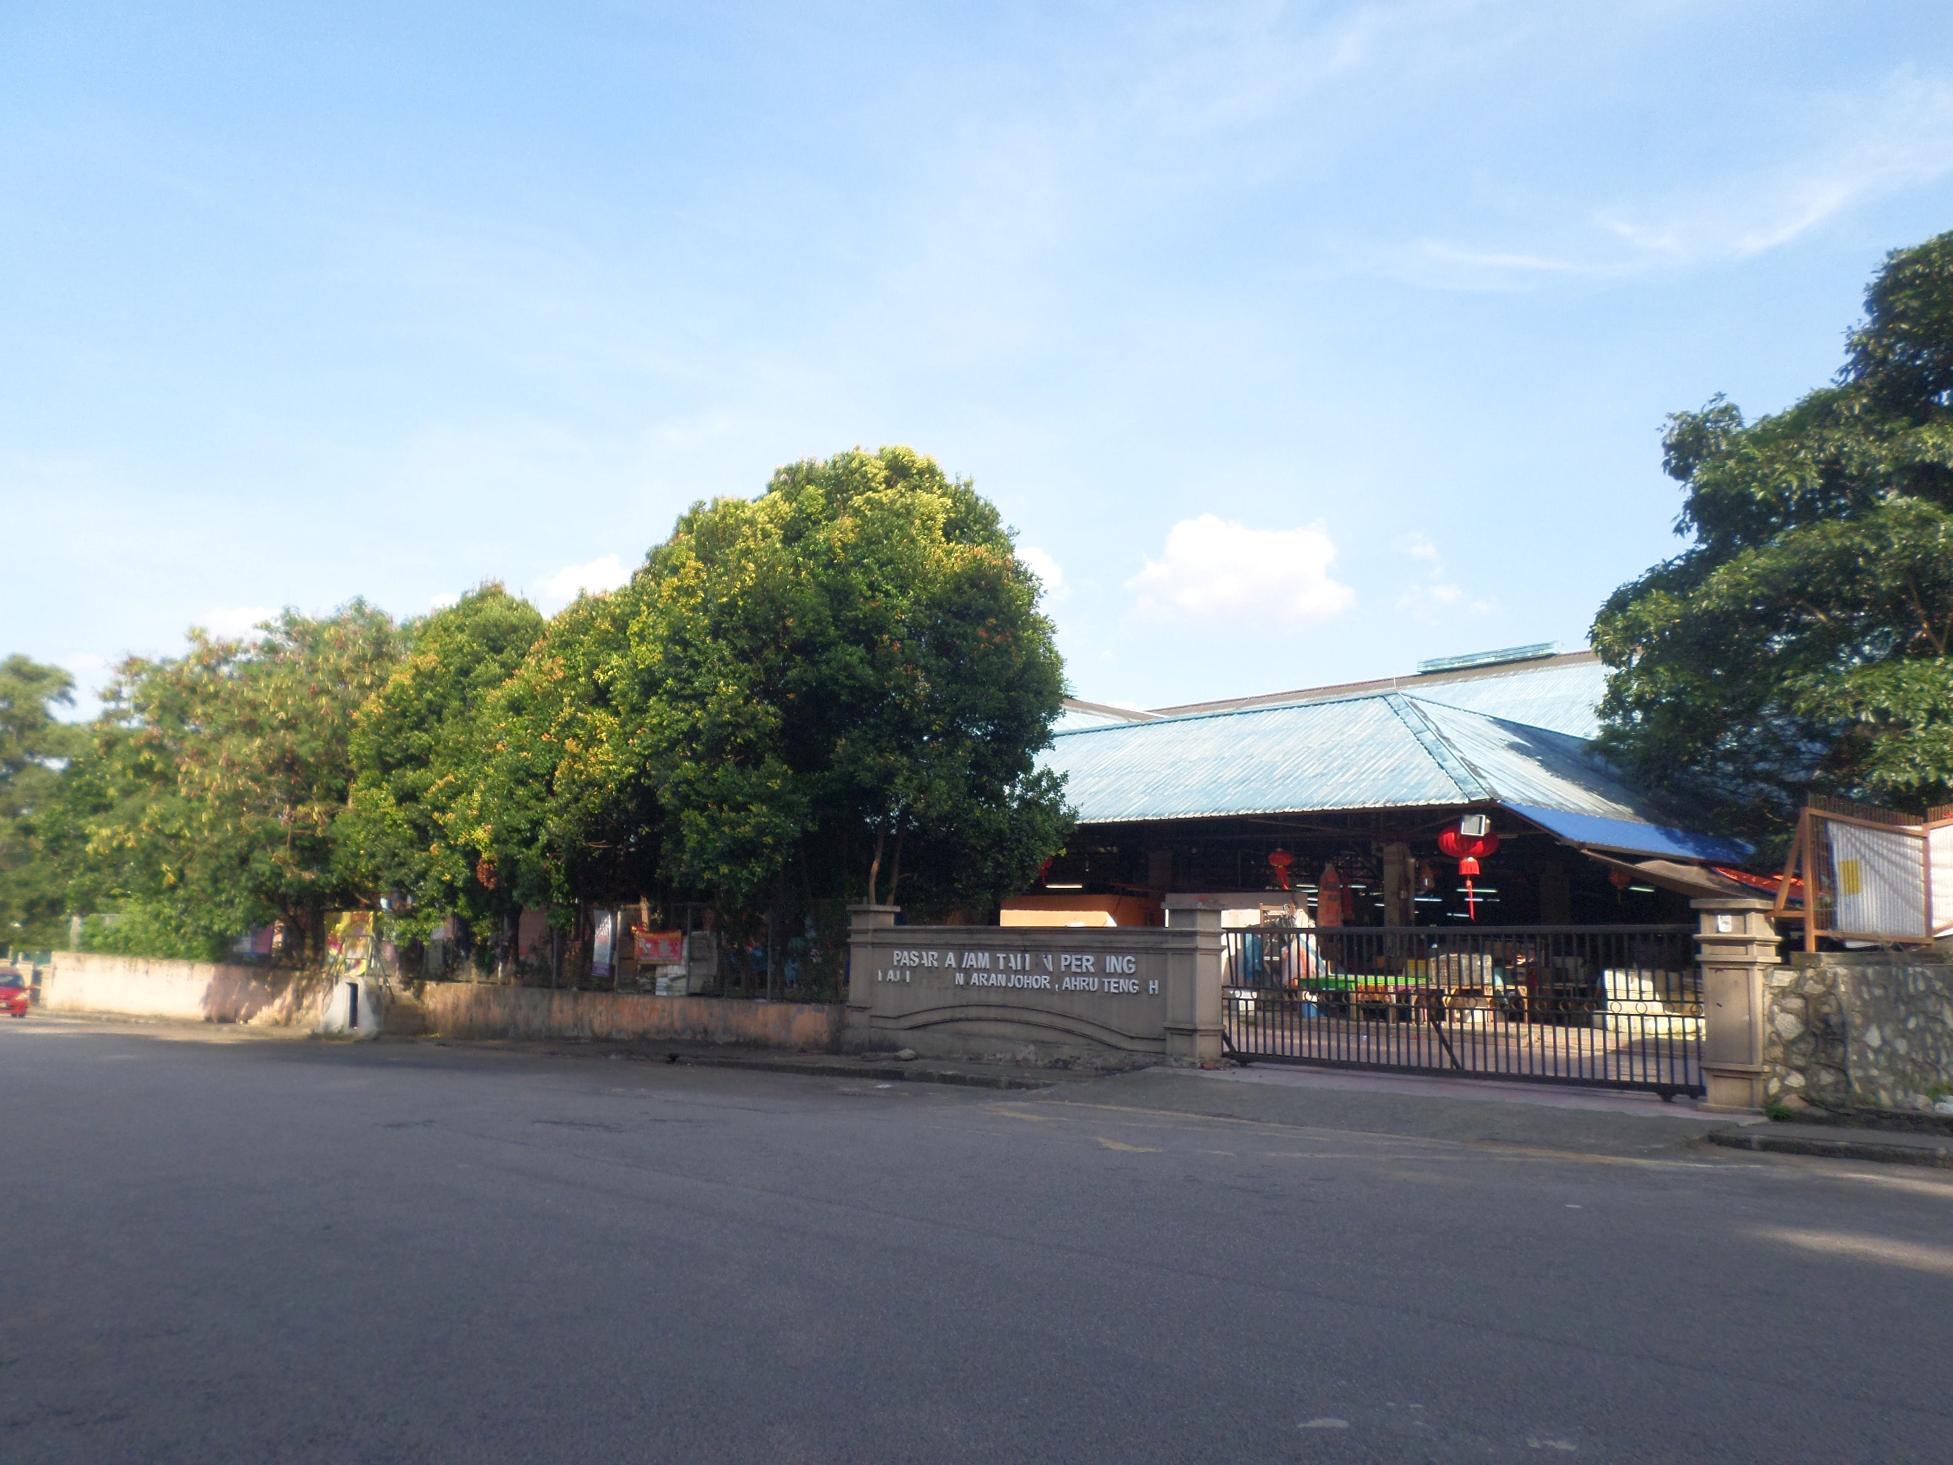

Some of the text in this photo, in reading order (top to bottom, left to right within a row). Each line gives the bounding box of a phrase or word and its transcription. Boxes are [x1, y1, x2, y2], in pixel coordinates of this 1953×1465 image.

[1061, 955, 1136, 974] PERING
[1007, 975, 1051, 989] JOHOR
[1055, 977, 1098, 992] AHRU
[1102, 978, 1159, 994] TENGH
